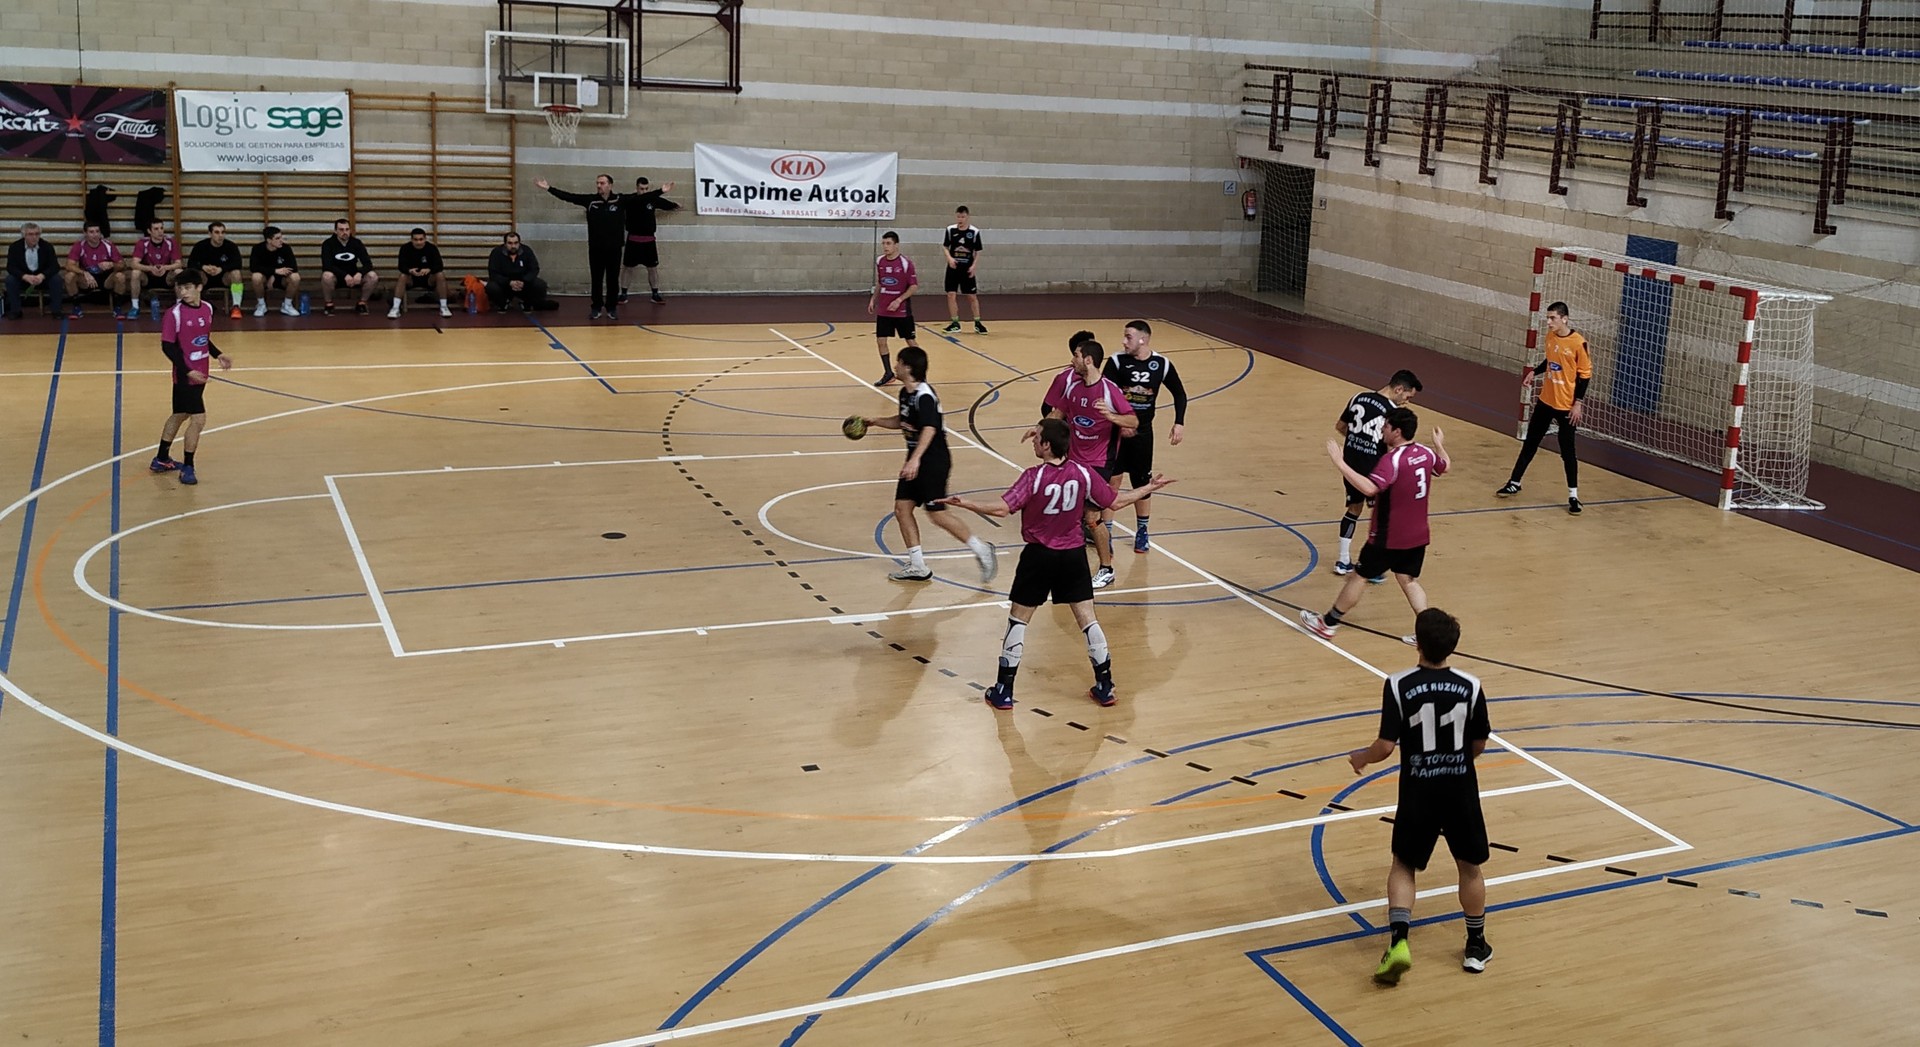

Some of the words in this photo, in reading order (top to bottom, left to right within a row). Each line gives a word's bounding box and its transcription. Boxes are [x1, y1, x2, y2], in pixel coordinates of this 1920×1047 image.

[181, 96, 257, 136] Logic
[267, 107, 343, 137] sage
[184, 141, 234, 149] SOLUCIONES
[217, 153, 314, 164] www.logicsage.es
[780, 160, 815, 176] KIA
[700, 178, 803, 204] Txapime
[807, 184, 890, 203] Autoak
[781, 209, 818, 217] ARRASATE
[827, 209, 847, 217] 943
[850, 209, 862, 217] 79
[865, 209, 876, 217] 45
[879, 209, 890, 217] 22
[198, 317, 205, 327] 5
[1130, 371, 1150, 383] 32
[1081, 397, 1088, 408] 12
[1349, 404, 1386, 443] 34
[1415, 468, 1427, 499] 3
[1044, 480, 1079, 515] 20
[1405, 683, 1429, 700] GURE
[1408, 702, 1469, 752] 11
